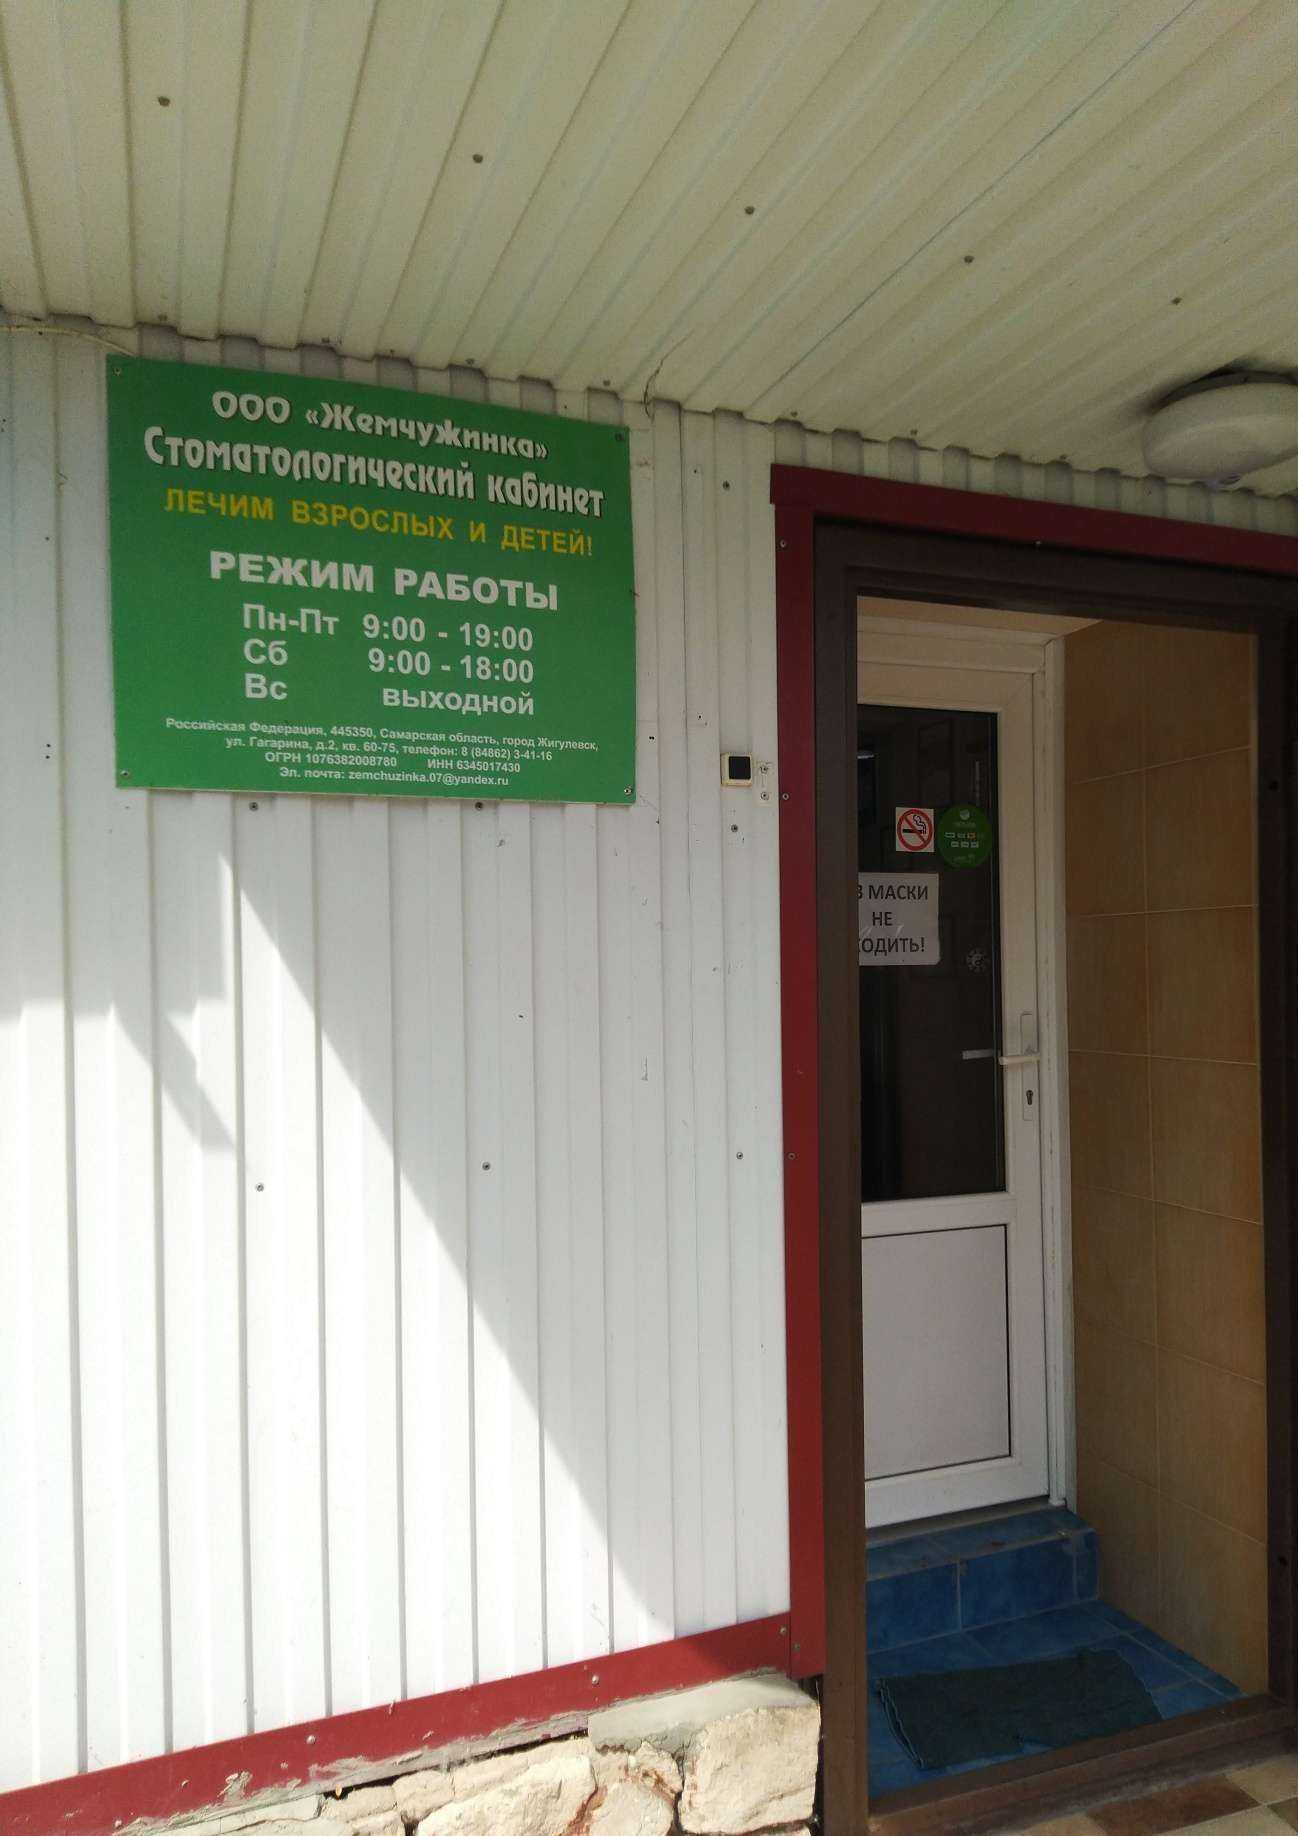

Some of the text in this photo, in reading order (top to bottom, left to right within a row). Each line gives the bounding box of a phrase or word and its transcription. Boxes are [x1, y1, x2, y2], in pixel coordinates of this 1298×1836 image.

[212, 391, 548, 459] ООО «Жемчужинка»
[144, 426, 604, 517] Стоматологический кабинет
[164, 488, 593, 556] ЛЕЧИМ ВЗРОСЛЫХ И ДЕТЕЙ!
[210, 550, 558, 610] РЕЖИМ РАБОТЫ
[243, 603, 339, 635] Пн-Пт
[362, 613, 426, 642] 9:00
[460, 622, 533, 651] 19:00
[244, 638, 288, 666] Сб
[368, 648, 431, 676] 9:00
[460, 655, 534, 683] 18:00
[245, 673, 288, 700] Вс
[166, 718, 599, 751] Российская Федерация, 445350, Самарская область, город Жигулевск,
[225, 738, 246, 749] ул.
[249, 736, 312, 751] Гагарина,
[342, 742, 360, 752] кв.
[363, 742, 399, 754] 60-75,
[402, 745, 458, 757] телефон:
[461, 746, 468, 757] 8
[472, 747, 511, 760] (84862)
[514, 749, 553, 761] 3-41-16
[265, 751, 301, 763] ОГРН
[428, 759, 453, 769] ИНН
[457, 760, 521, 772] 6345017430
[280, 767, 509, 786] Эл. почта: zemchuzinka.07@yandex.ru
[868, 884, 928, 900] МАСКИ
[872, 911, 893, 926] НЕ
